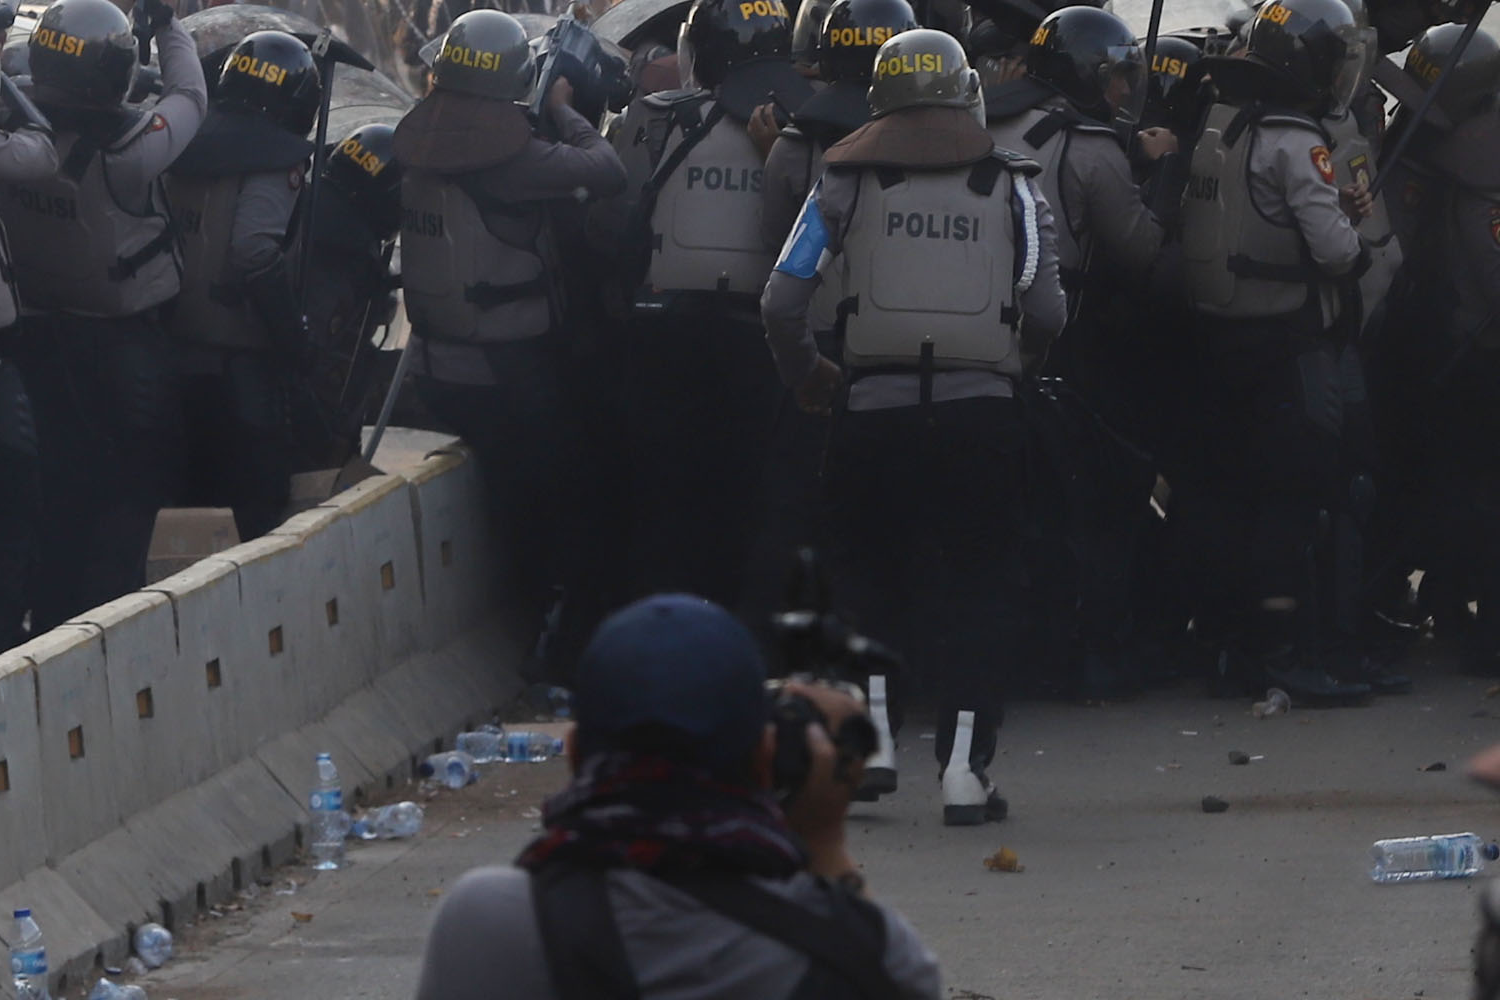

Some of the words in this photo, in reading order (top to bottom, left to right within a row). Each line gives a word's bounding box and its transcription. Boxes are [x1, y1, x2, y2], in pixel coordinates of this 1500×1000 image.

[231, 53, 287, 86] POLISI
[443, 44, 501, 72] POLISI
[878, 54, 943, 80] POLISI
[1151, 54, 1188, 79] LISI
[687, 166, 764, 193] POLIS
[887, 212, 979, 242] POLISI
